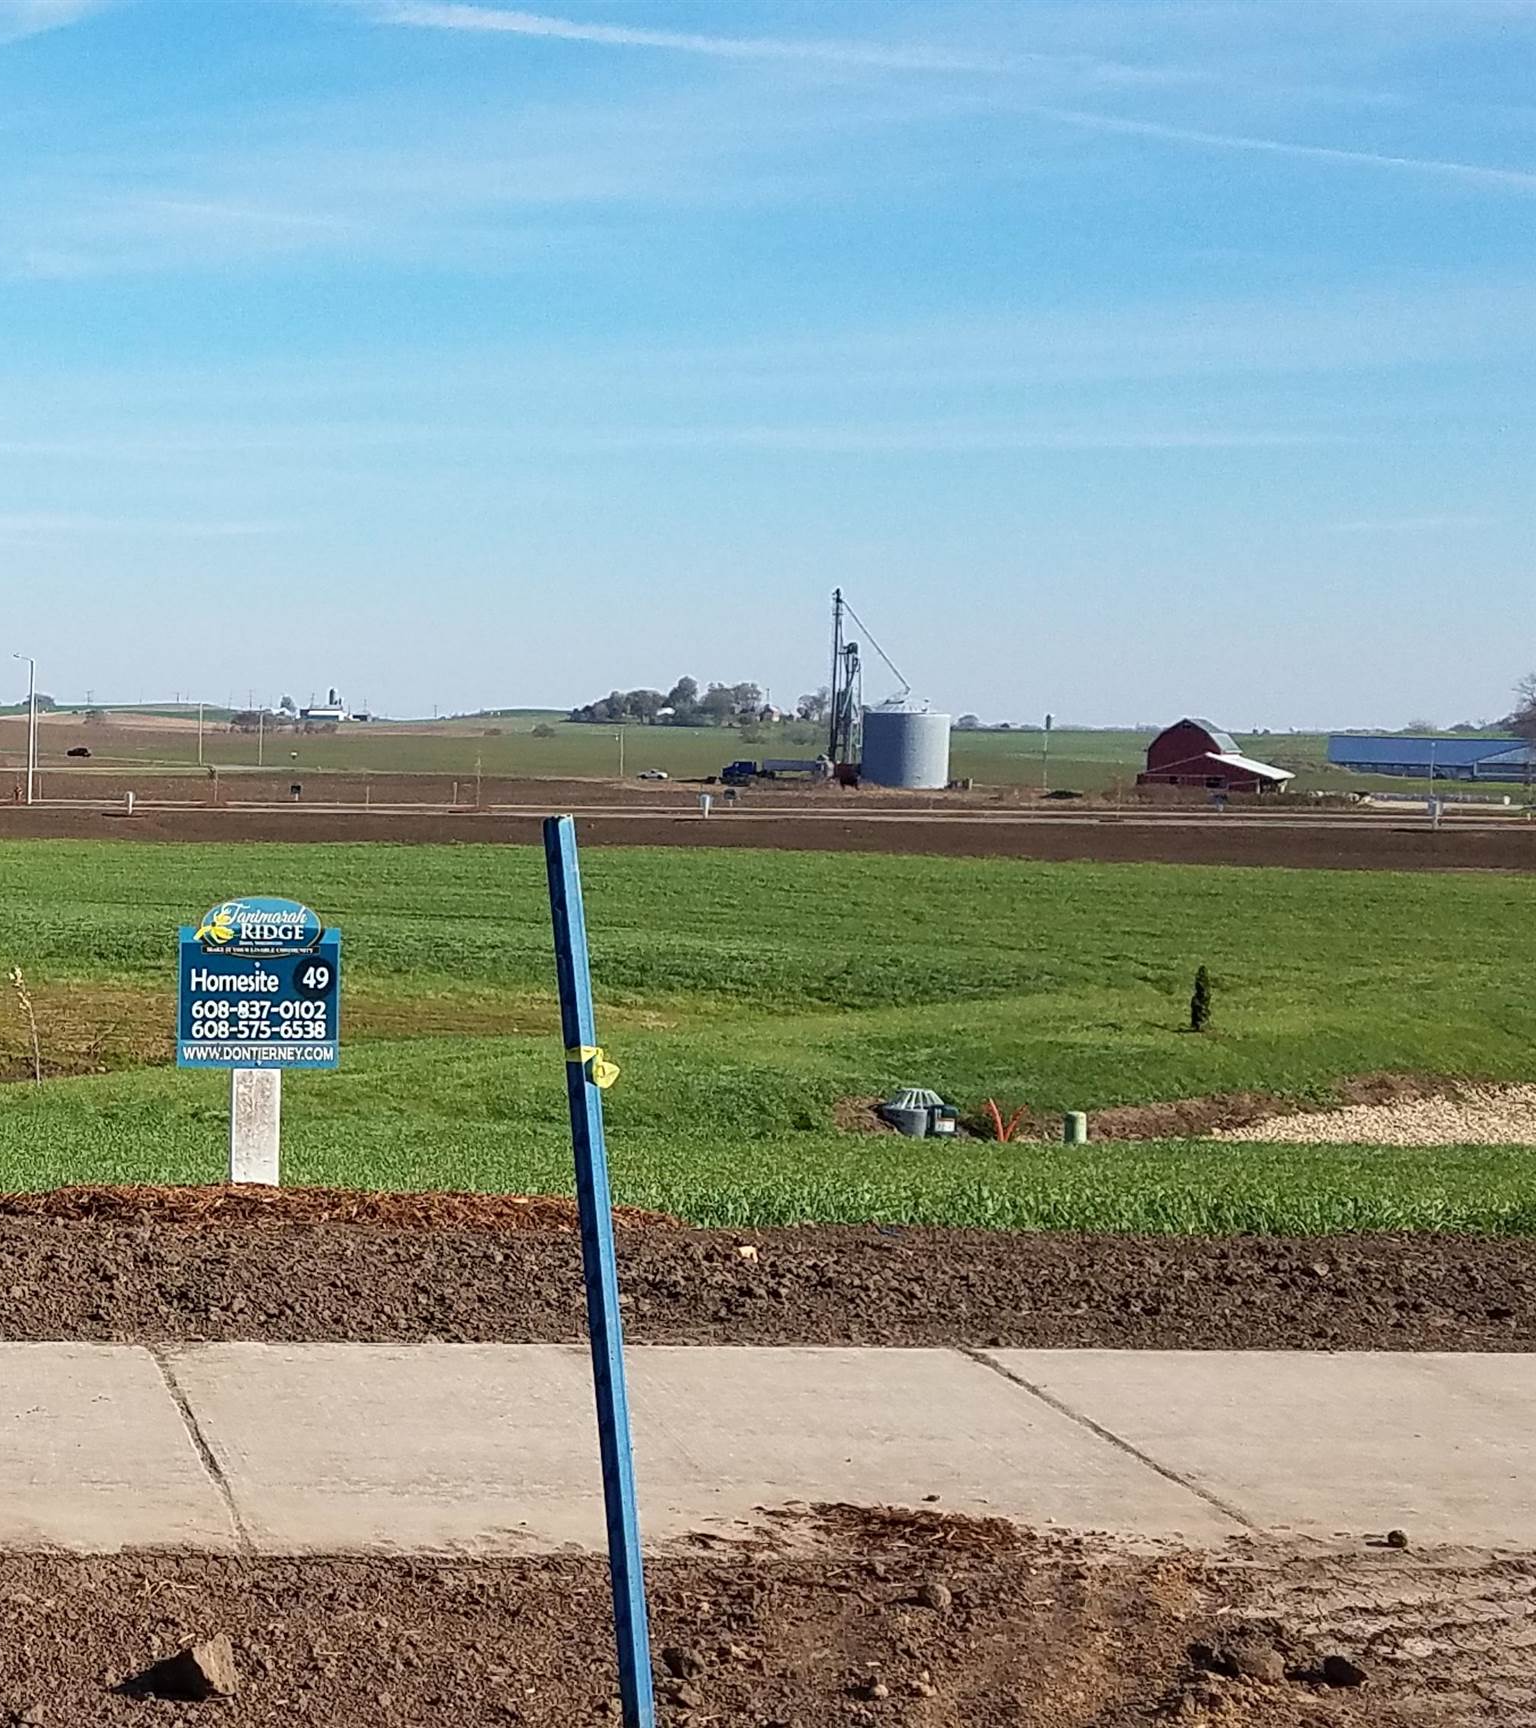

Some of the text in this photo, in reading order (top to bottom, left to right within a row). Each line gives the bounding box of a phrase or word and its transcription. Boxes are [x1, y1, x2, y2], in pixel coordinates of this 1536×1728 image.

[240, 925, 304, 940] RIDGE
[191, 967, 329, 992] Homesite 49
[191, 1000, 327, 1020] 608-837-0102
[191, 1020, 327, 1039] 608-575-6538
[183, 1046, 334, 1061] WWW.DONTIERNEY.COM
